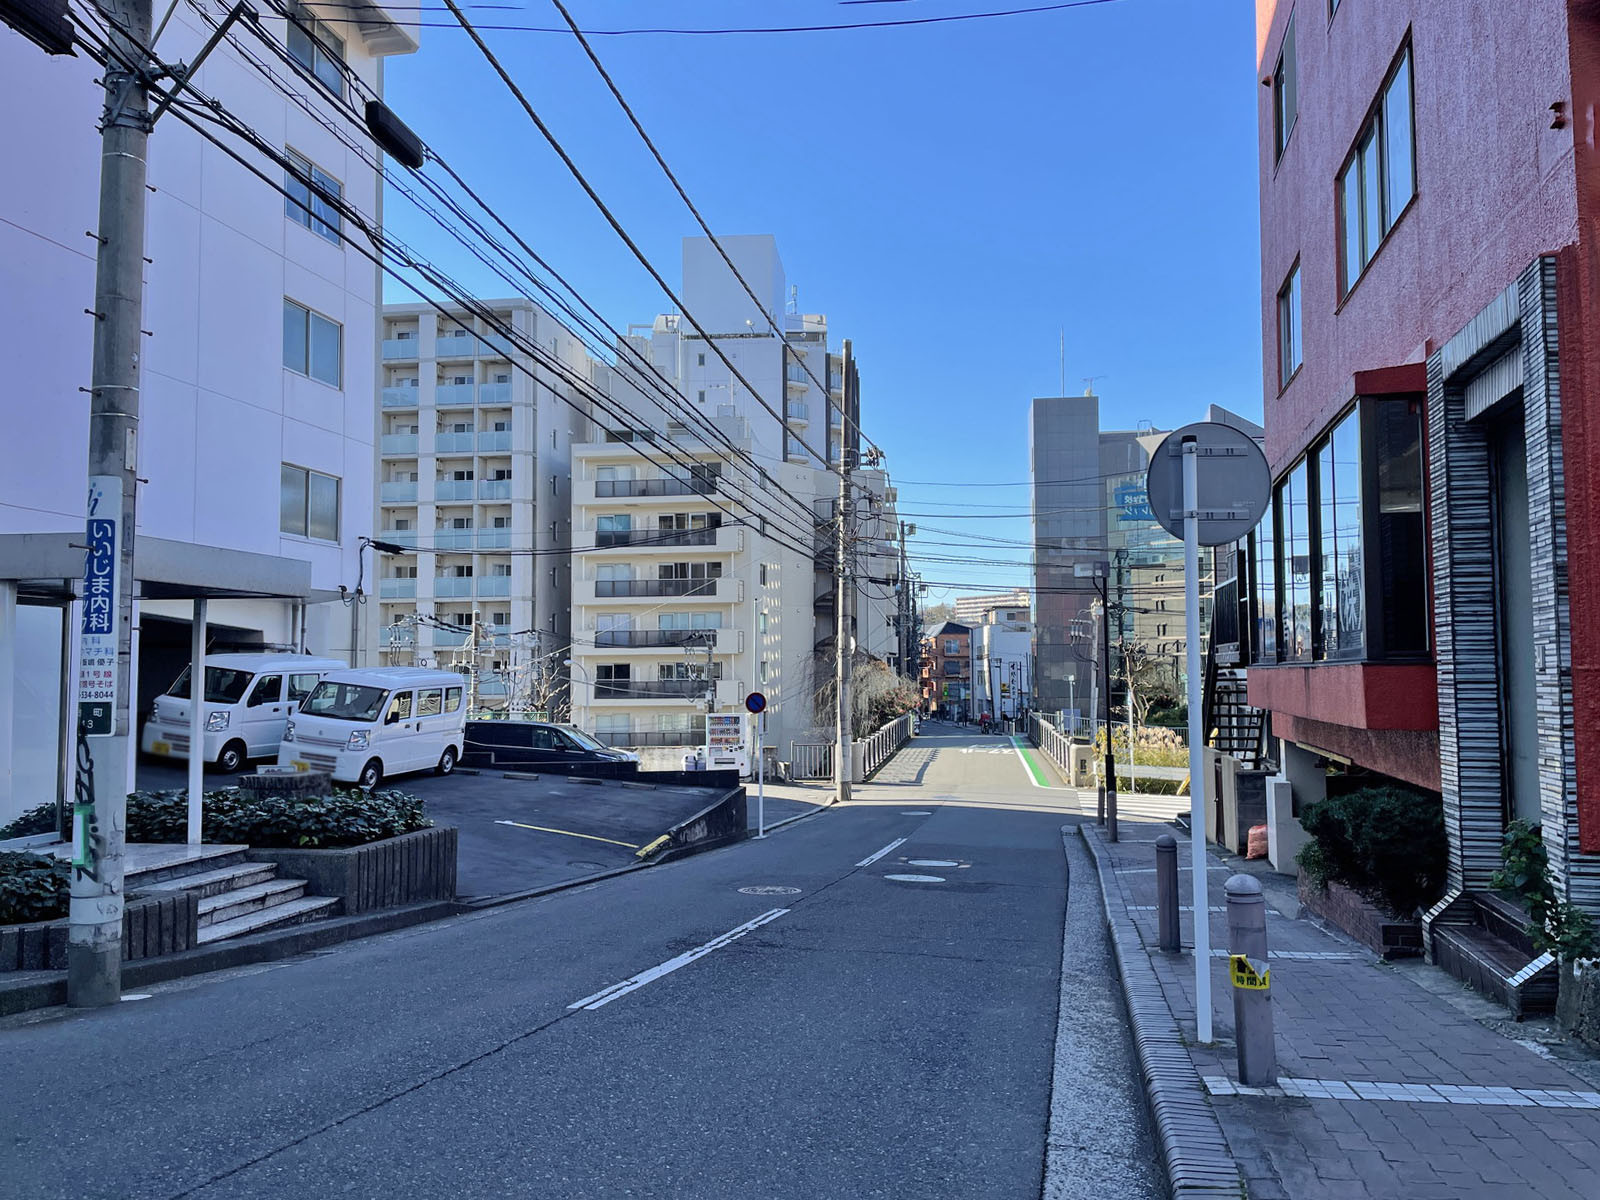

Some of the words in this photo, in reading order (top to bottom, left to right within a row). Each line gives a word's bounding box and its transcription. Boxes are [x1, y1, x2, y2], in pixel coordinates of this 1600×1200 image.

[89, 521, 112, 633] いいじま内科
